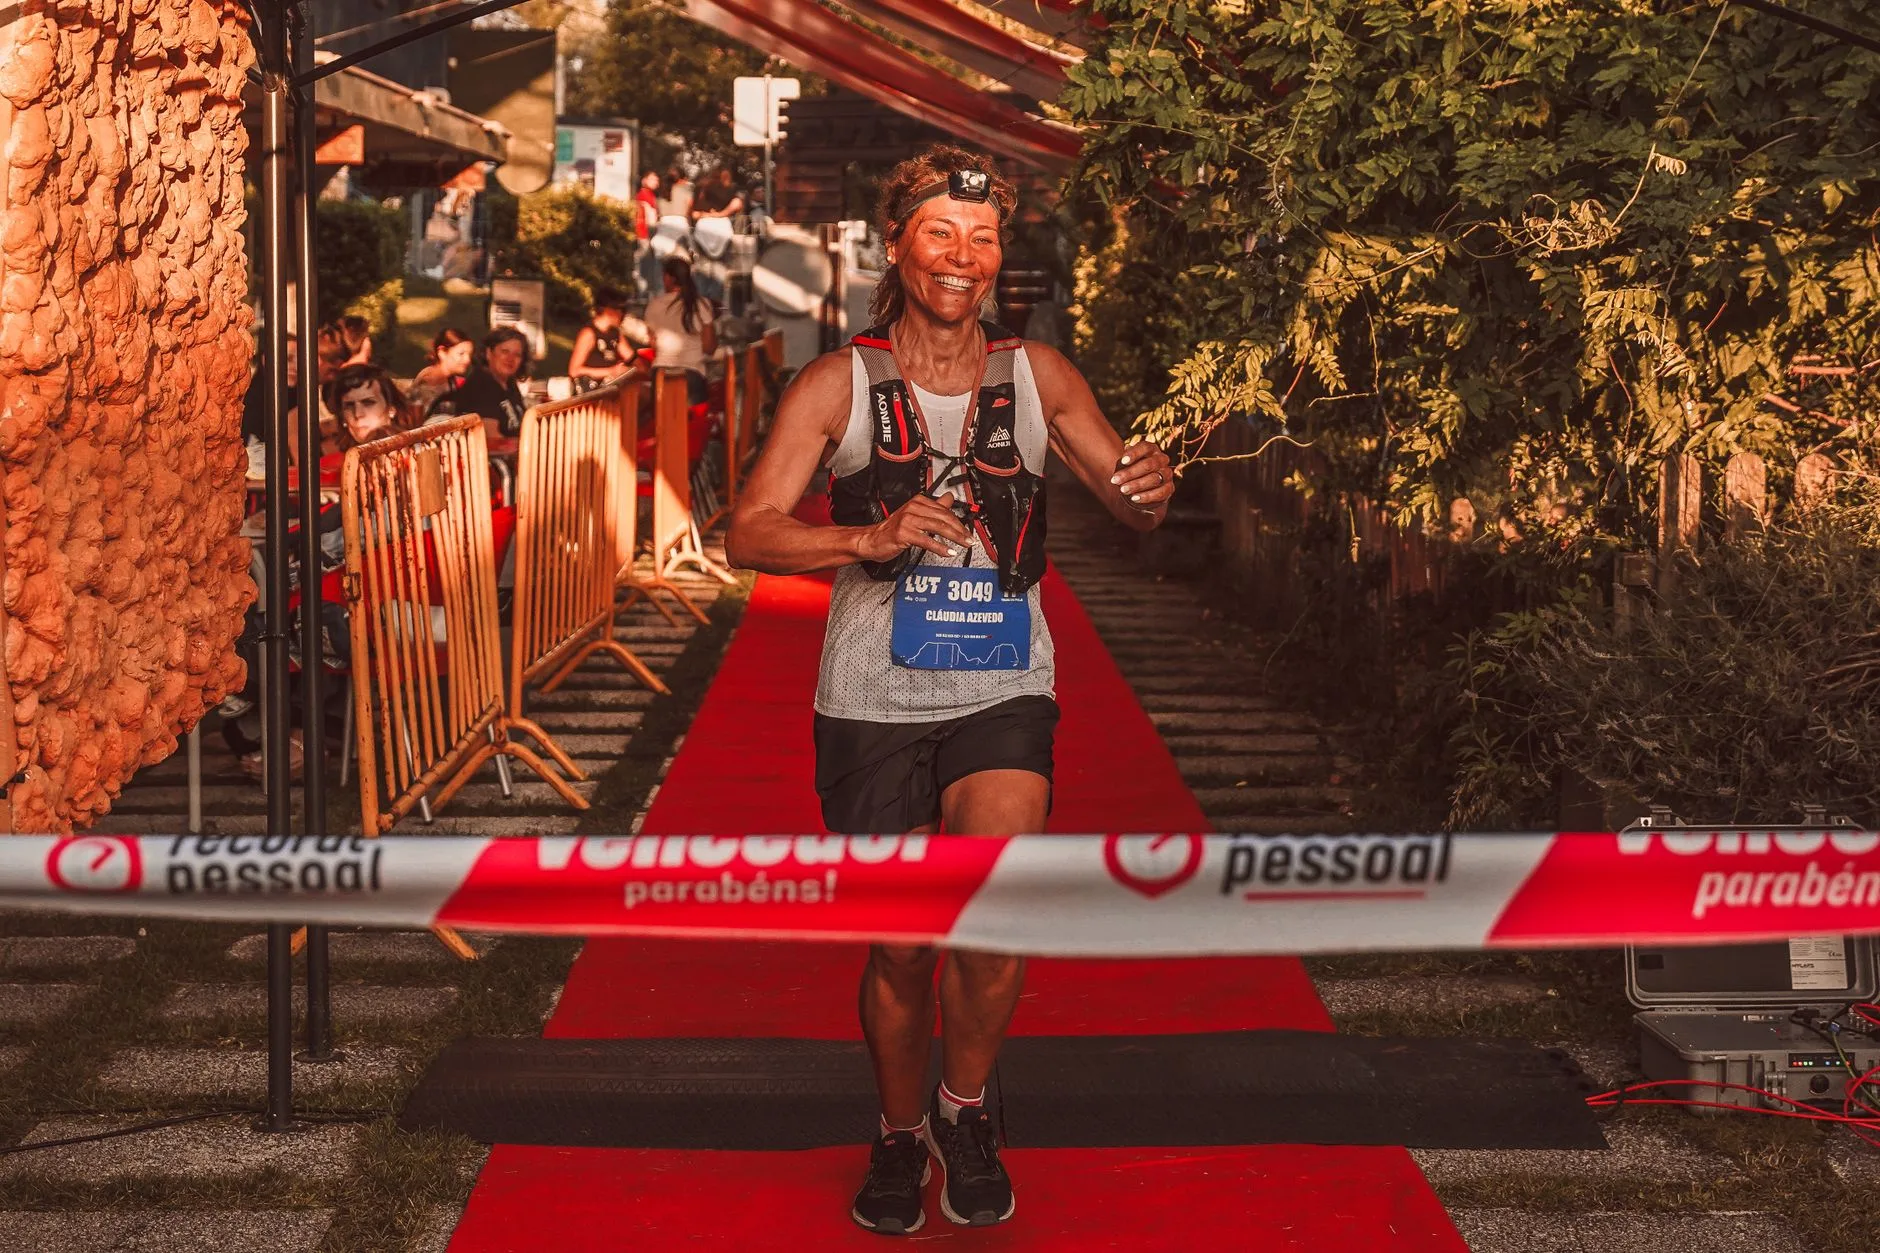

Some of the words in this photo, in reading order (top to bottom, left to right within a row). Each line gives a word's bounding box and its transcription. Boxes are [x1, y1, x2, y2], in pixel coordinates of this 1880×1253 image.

[876, 393, 891, 442] AONIJIE
[905, 575, 941, 594] LUT
[947, 580, 994, 602] 3049
[925, 608, 966, 623] CLÁUDIA
[967, 611, 1004, 624] AZEVEDO
[167, 847, 381, 894] pessoal
[1220, 834, 1451, 896] pessoal
[623, 869, 838, 910] parabéns!
